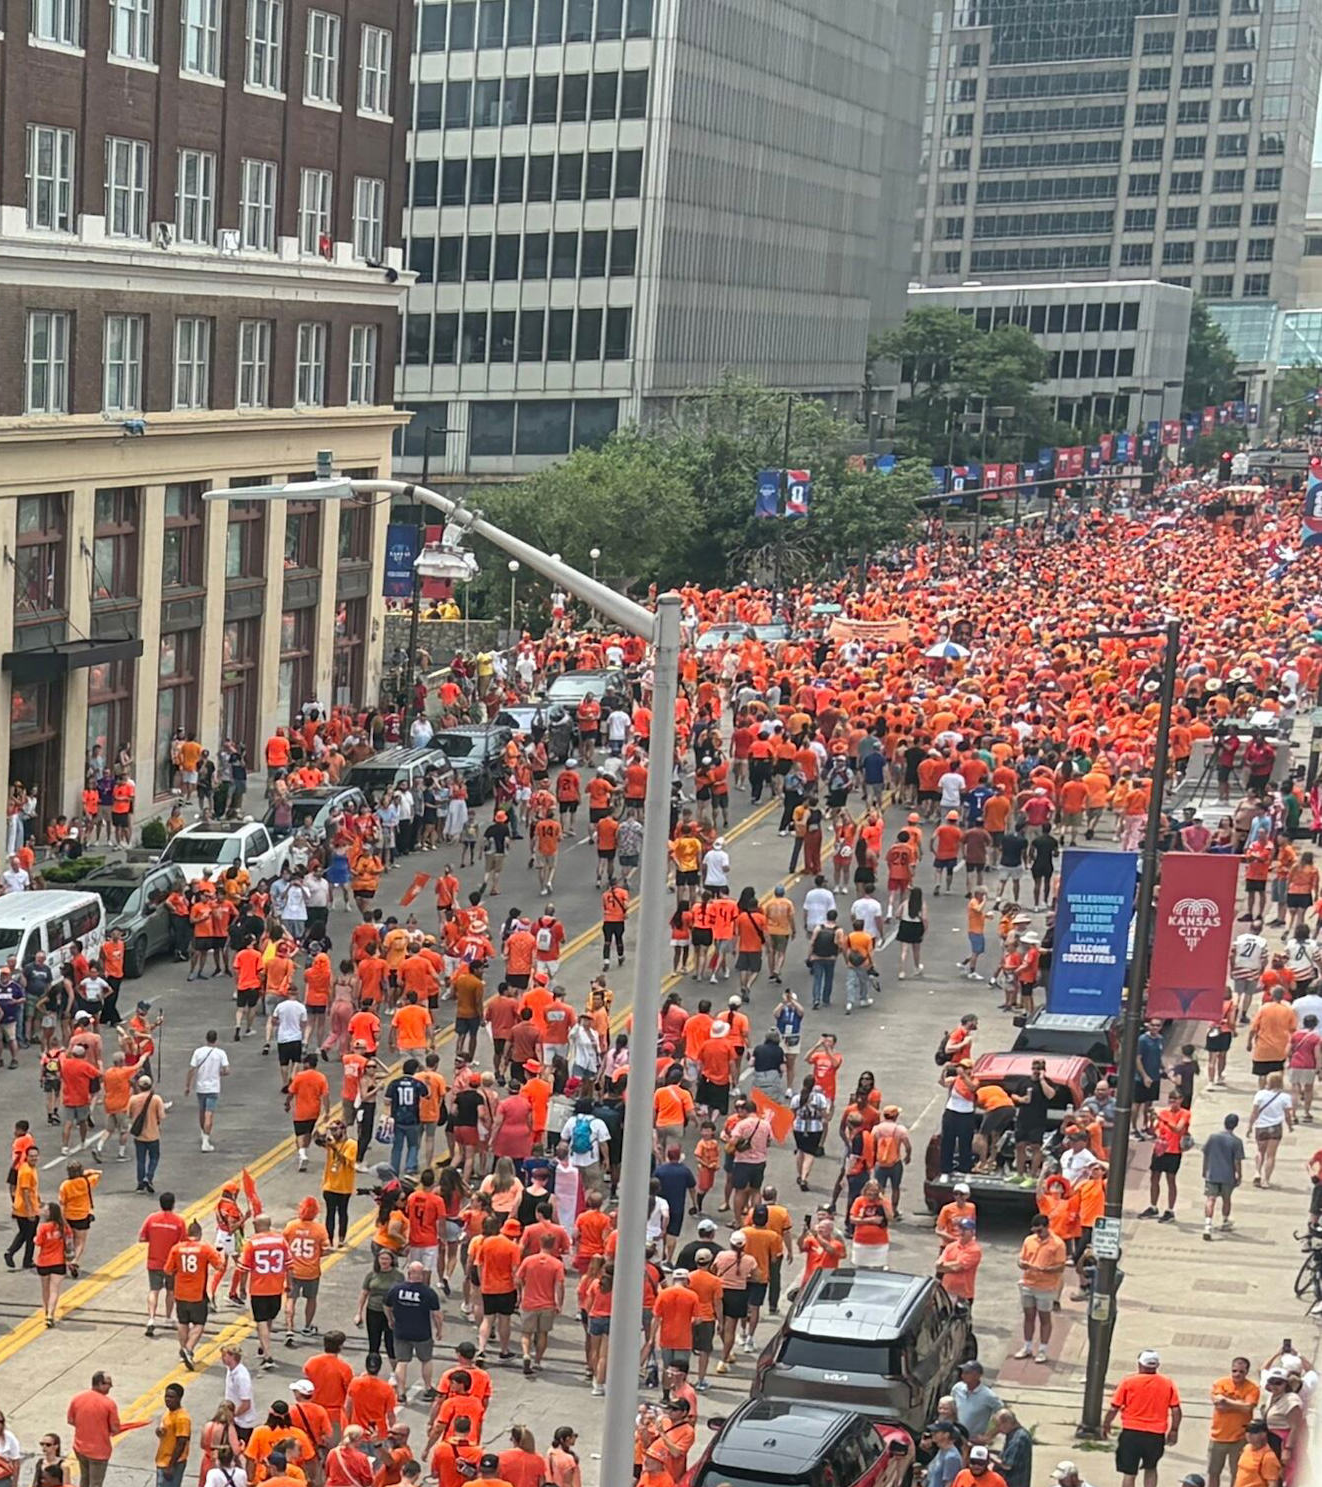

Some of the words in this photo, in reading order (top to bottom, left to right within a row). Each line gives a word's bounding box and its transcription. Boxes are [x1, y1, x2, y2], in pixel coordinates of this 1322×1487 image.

[1167, 915, 1222, 927] KANSAS
[1178, 926, 1210, 937] CITY
[1069, 944, 1111, 955] WELCOME
[1240, 942, 1258, 958] 21
[397, 1086, 414, 1106] 10
[290, 1237, 315, 1259] 45
[181, 1254, 200, 1273] 18
[254, 1249, 285, 1274] 53
